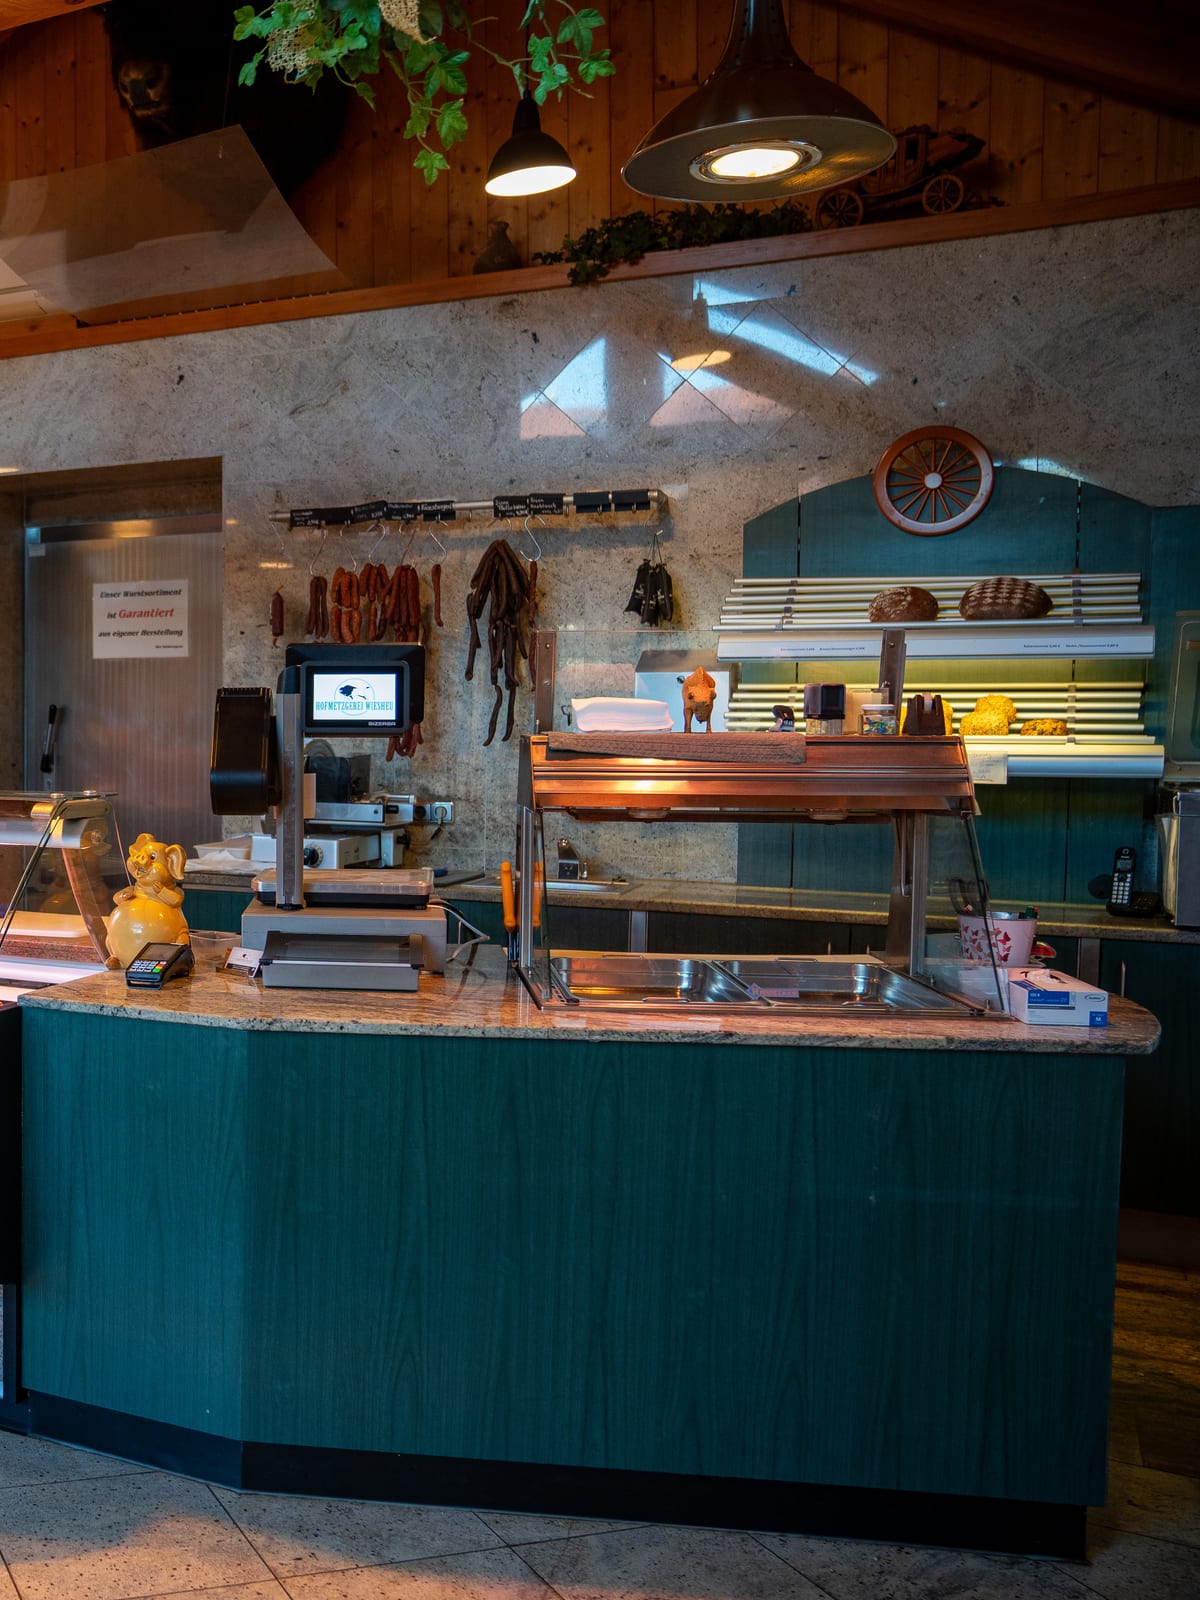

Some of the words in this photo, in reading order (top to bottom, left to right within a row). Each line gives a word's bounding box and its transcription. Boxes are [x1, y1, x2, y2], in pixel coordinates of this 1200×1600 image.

[123, 588, 182, 598] Wurstsortiment
[118, 608, 175, 619] Garantiert
[112, 630, 139, 638] eigener
[140, 629, 184, 638] Herstellung
[315, 701, 364, 711] HOFMETZGEREI
[366, 701, 394, 711] WIESHEU
